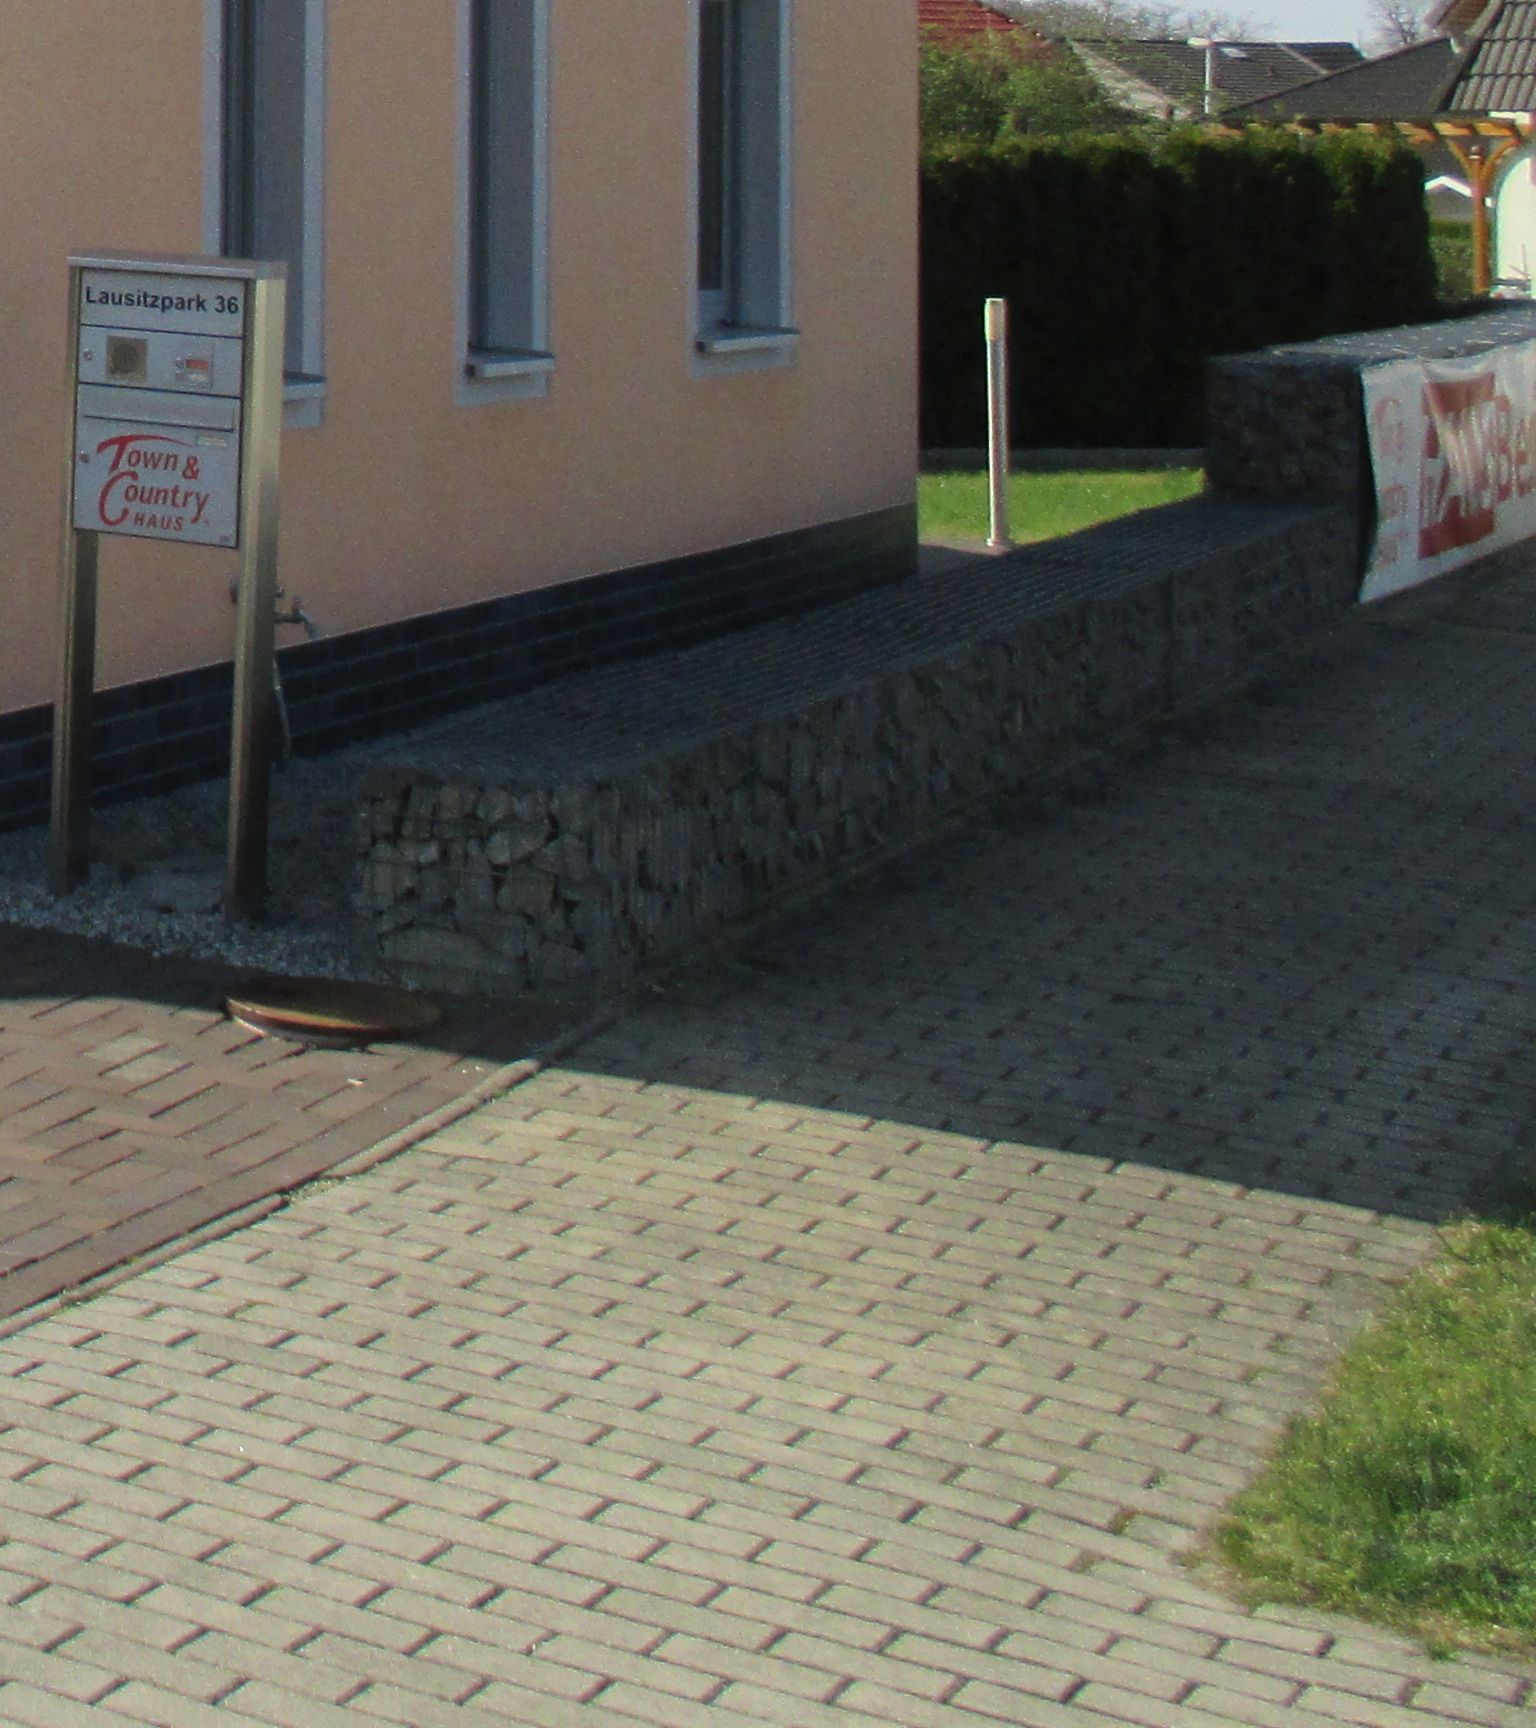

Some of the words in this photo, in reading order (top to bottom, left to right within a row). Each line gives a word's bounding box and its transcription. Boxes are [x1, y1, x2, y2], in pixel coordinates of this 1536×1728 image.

[85, 286, 207, 313] Lausitzpark
[214, 295, 239, 314] 36
[96, 434, 194, 474] Town
[182, 456, 200, 480] &
[98, 470, 210, 527] Country
[133, 513, 185, 532] HAUS
